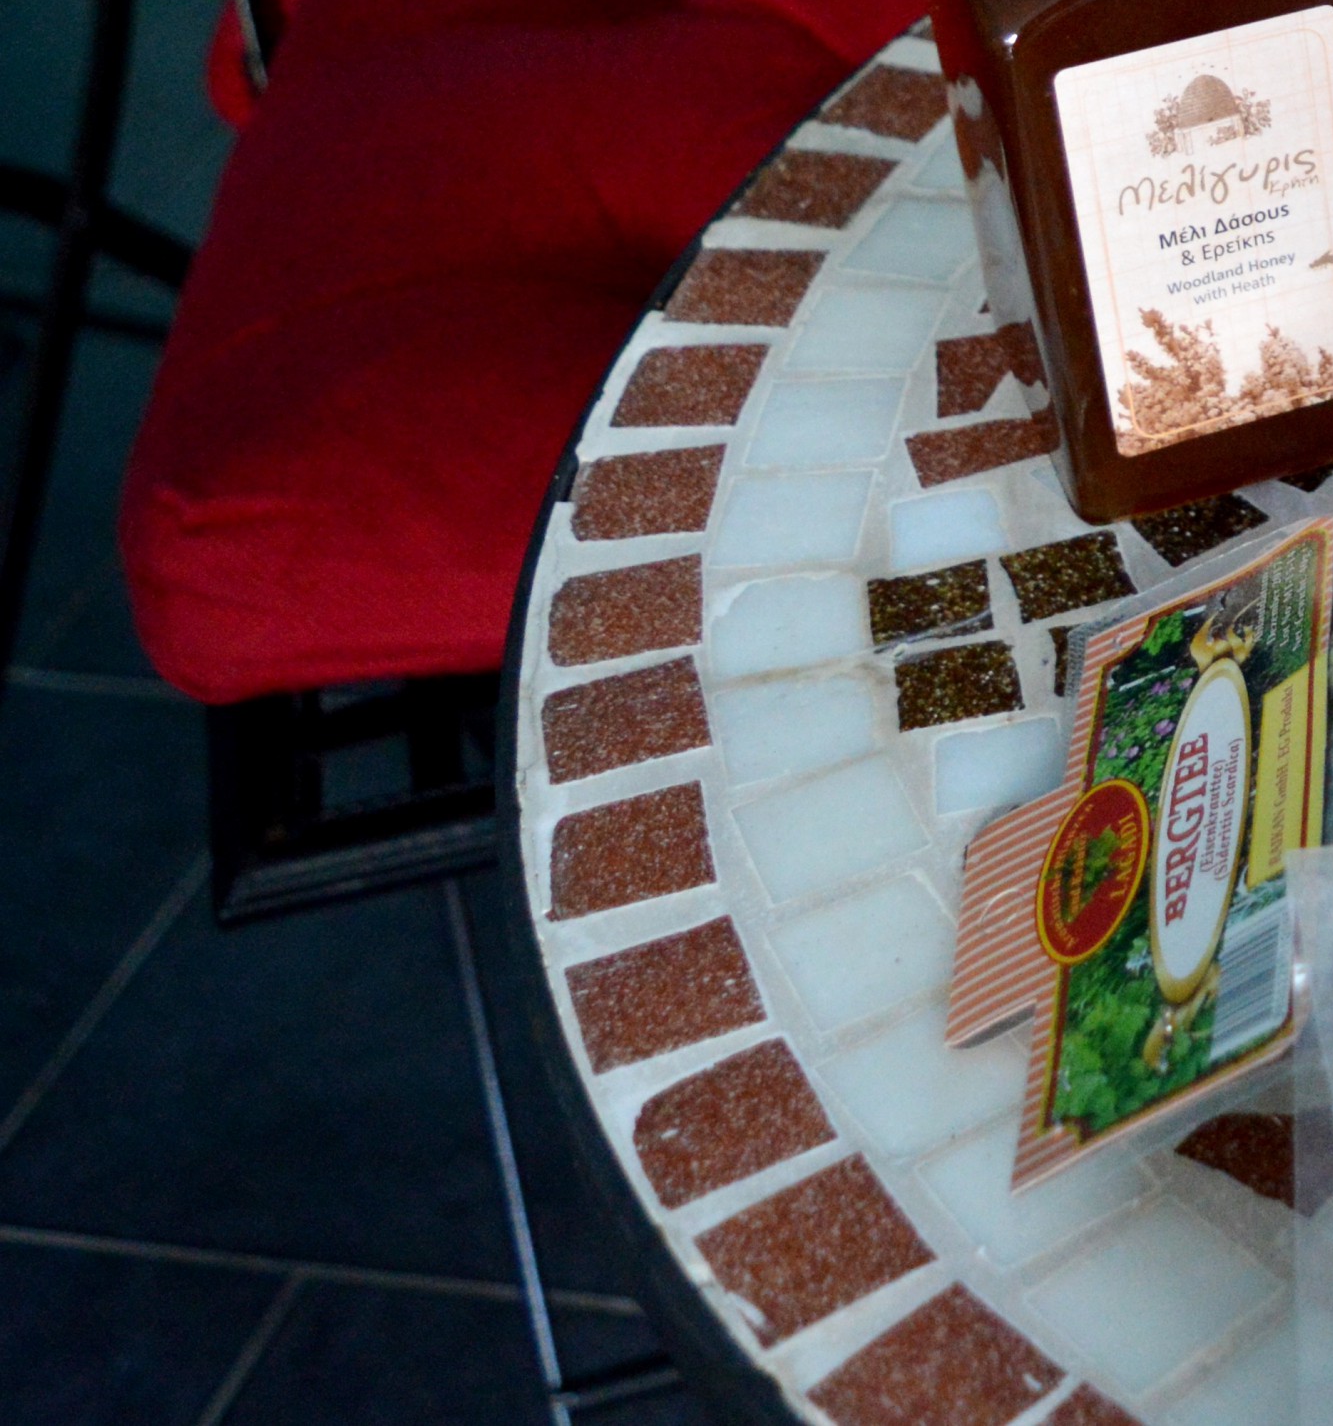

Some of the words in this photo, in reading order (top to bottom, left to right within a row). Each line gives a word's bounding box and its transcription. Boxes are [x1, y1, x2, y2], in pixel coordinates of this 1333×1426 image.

[1158, 225, 1208, 250] Μέλι
[1213, 203, 1291, 235] Δάσους
[1180, 249, 1197, 266] &
[1201, 230, 1276, 261] Ερείκης
[1166, 264, 1244, 296] Woodland
[1248, 252, 1297, 274] Honey
[1193, 286, 1229, 306] with
[1231, 273, 1276, 295] Heath
[1165, 733, 1208, 926] BERGTEE
[1106, 812, 1138, 898] LAGADI
